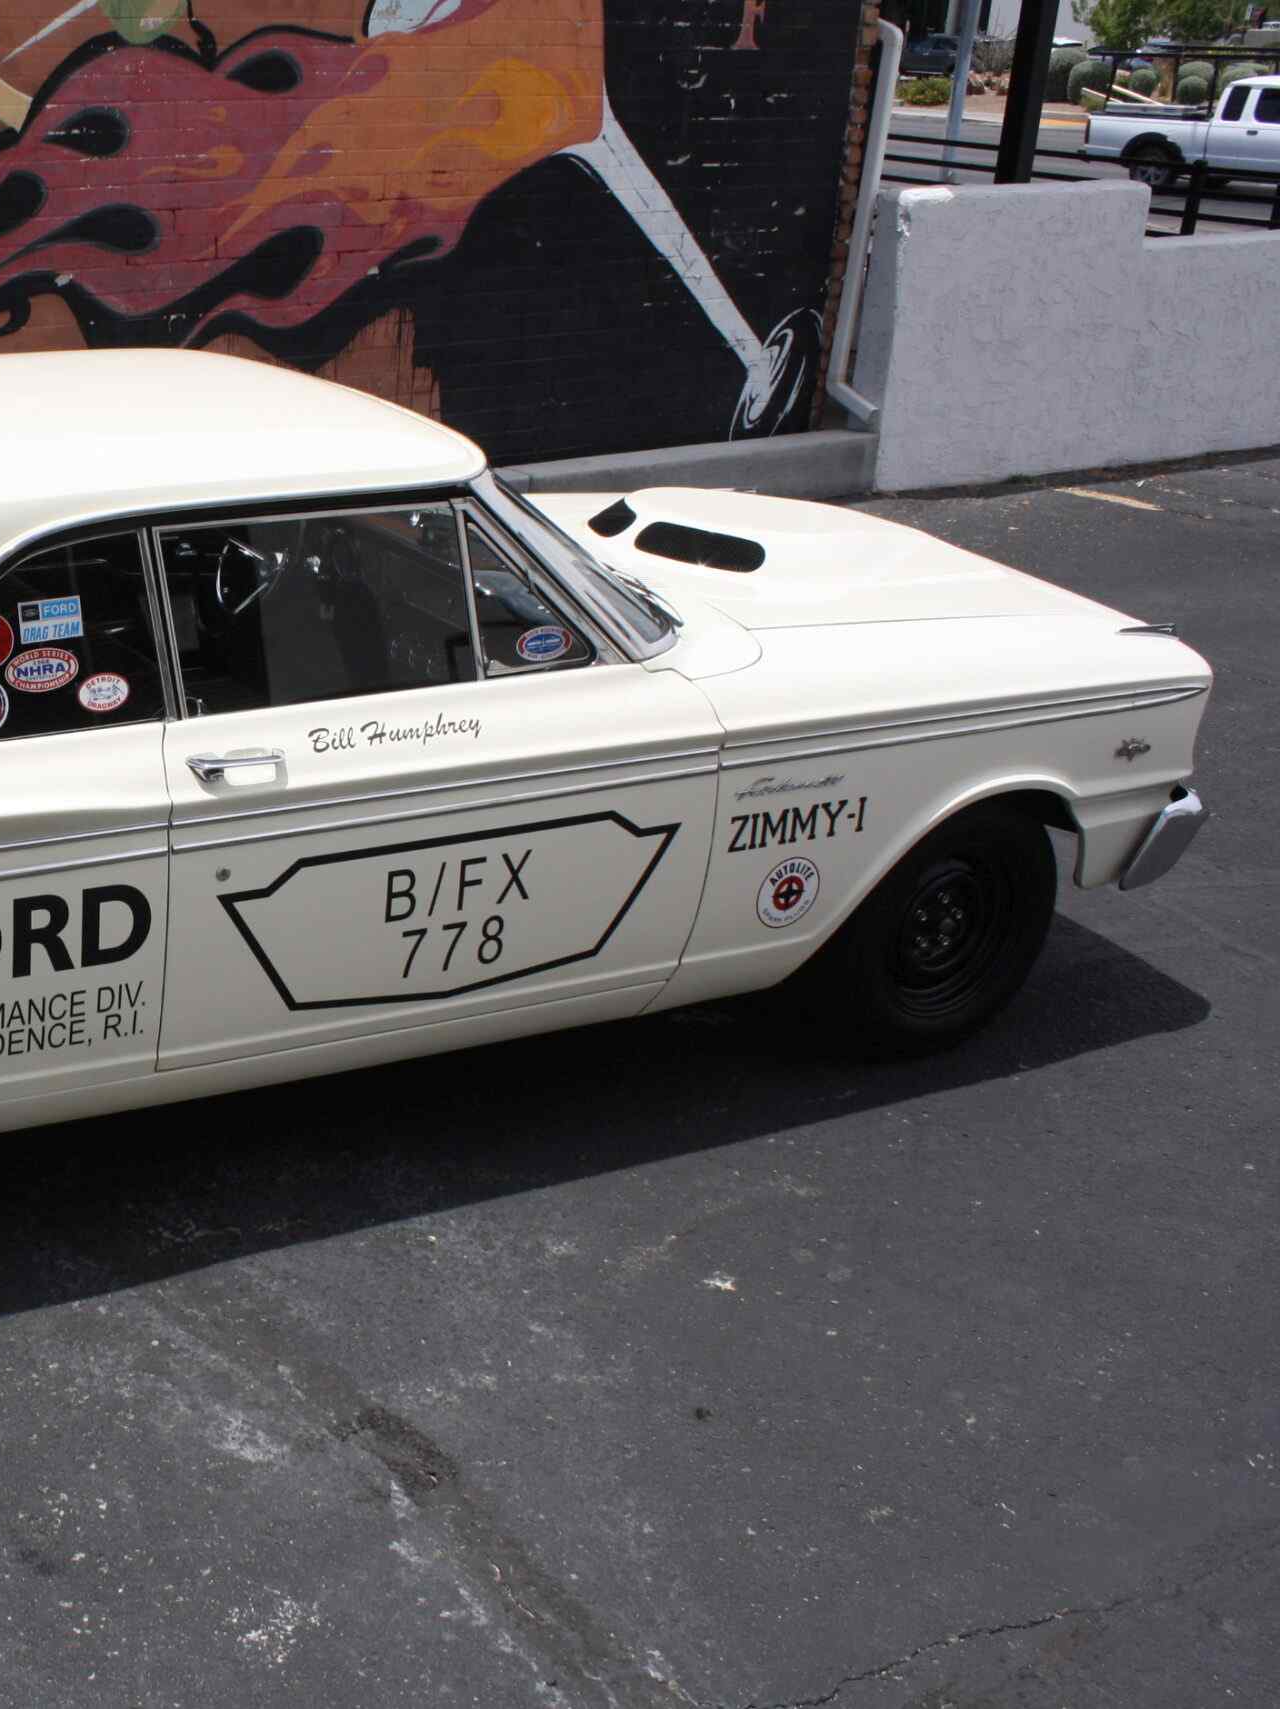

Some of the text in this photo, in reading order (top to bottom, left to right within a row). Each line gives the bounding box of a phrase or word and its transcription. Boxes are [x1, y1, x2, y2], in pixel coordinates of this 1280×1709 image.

[43, 601, 77, 616] FORD
[23, 620, 80, 642] DRAG TEAM
[42, 650, 70, 661] SERIES
[15, 662, 66, 678] NHRA
[86, 676, 121, 689] DETROIT
[307, 712, 482, 753] Bill Humphrey
[384, 848, 533, 923] B/FX
[769, 862, 816, 887] AUTOLITE
[402, 914, 505, 979] 778
[96, 980, 146, 1013] DIV.
[103, 1012, 145, 1041] R.I.
